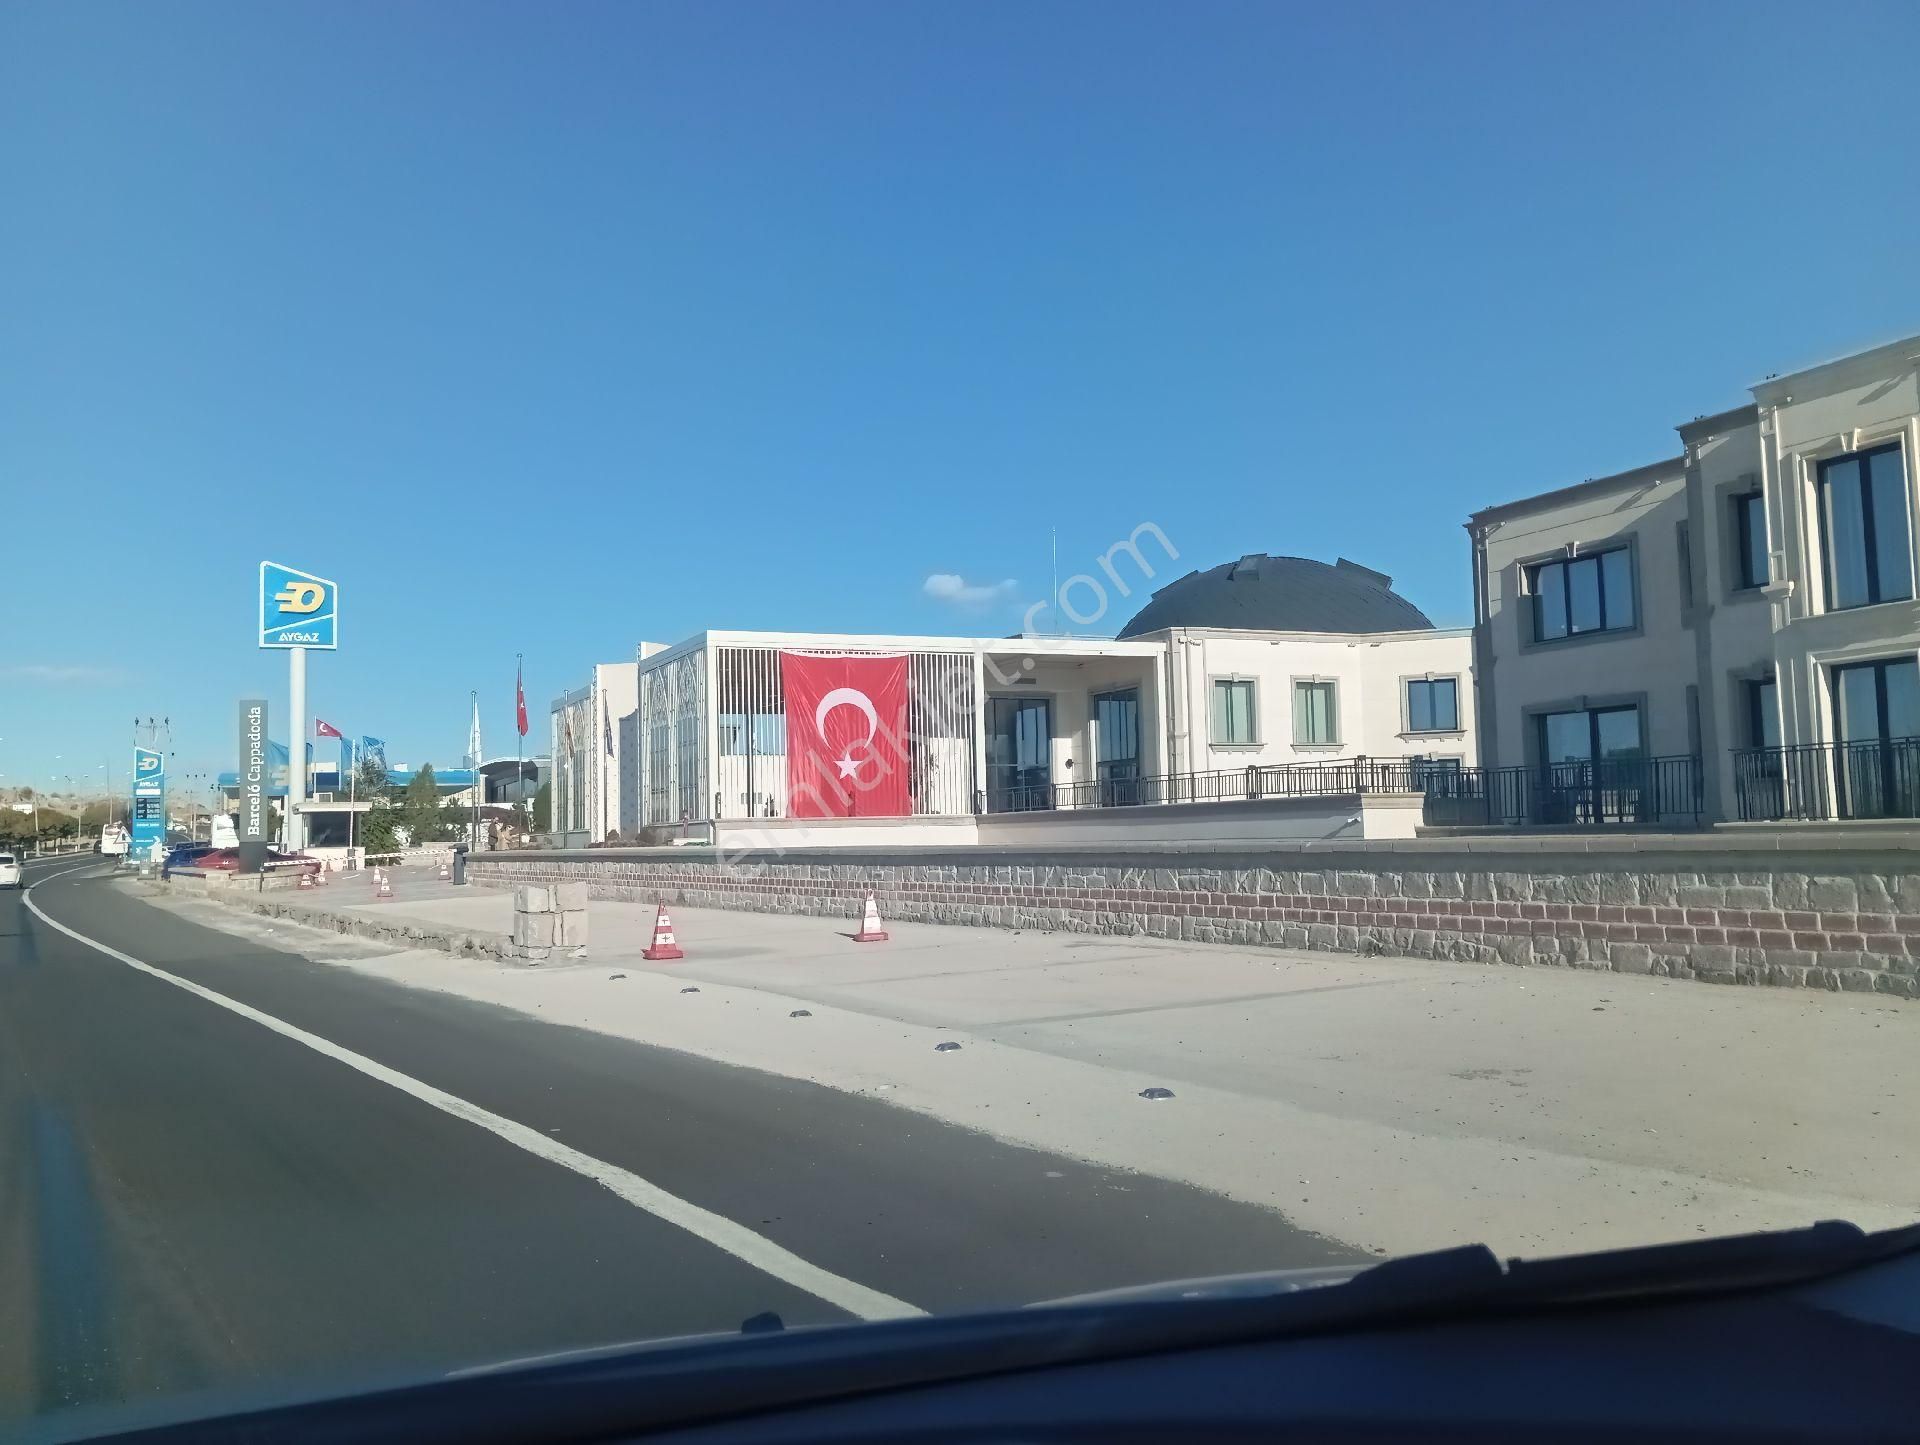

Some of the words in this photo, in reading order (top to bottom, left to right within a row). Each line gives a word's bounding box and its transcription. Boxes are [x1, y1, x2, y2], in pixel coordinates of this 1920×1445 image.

[278, 632, 320, 642] AYGAZ
[248, 706, 263, 781] Cappadocia
[247, 784, 260, 836] Barceló
